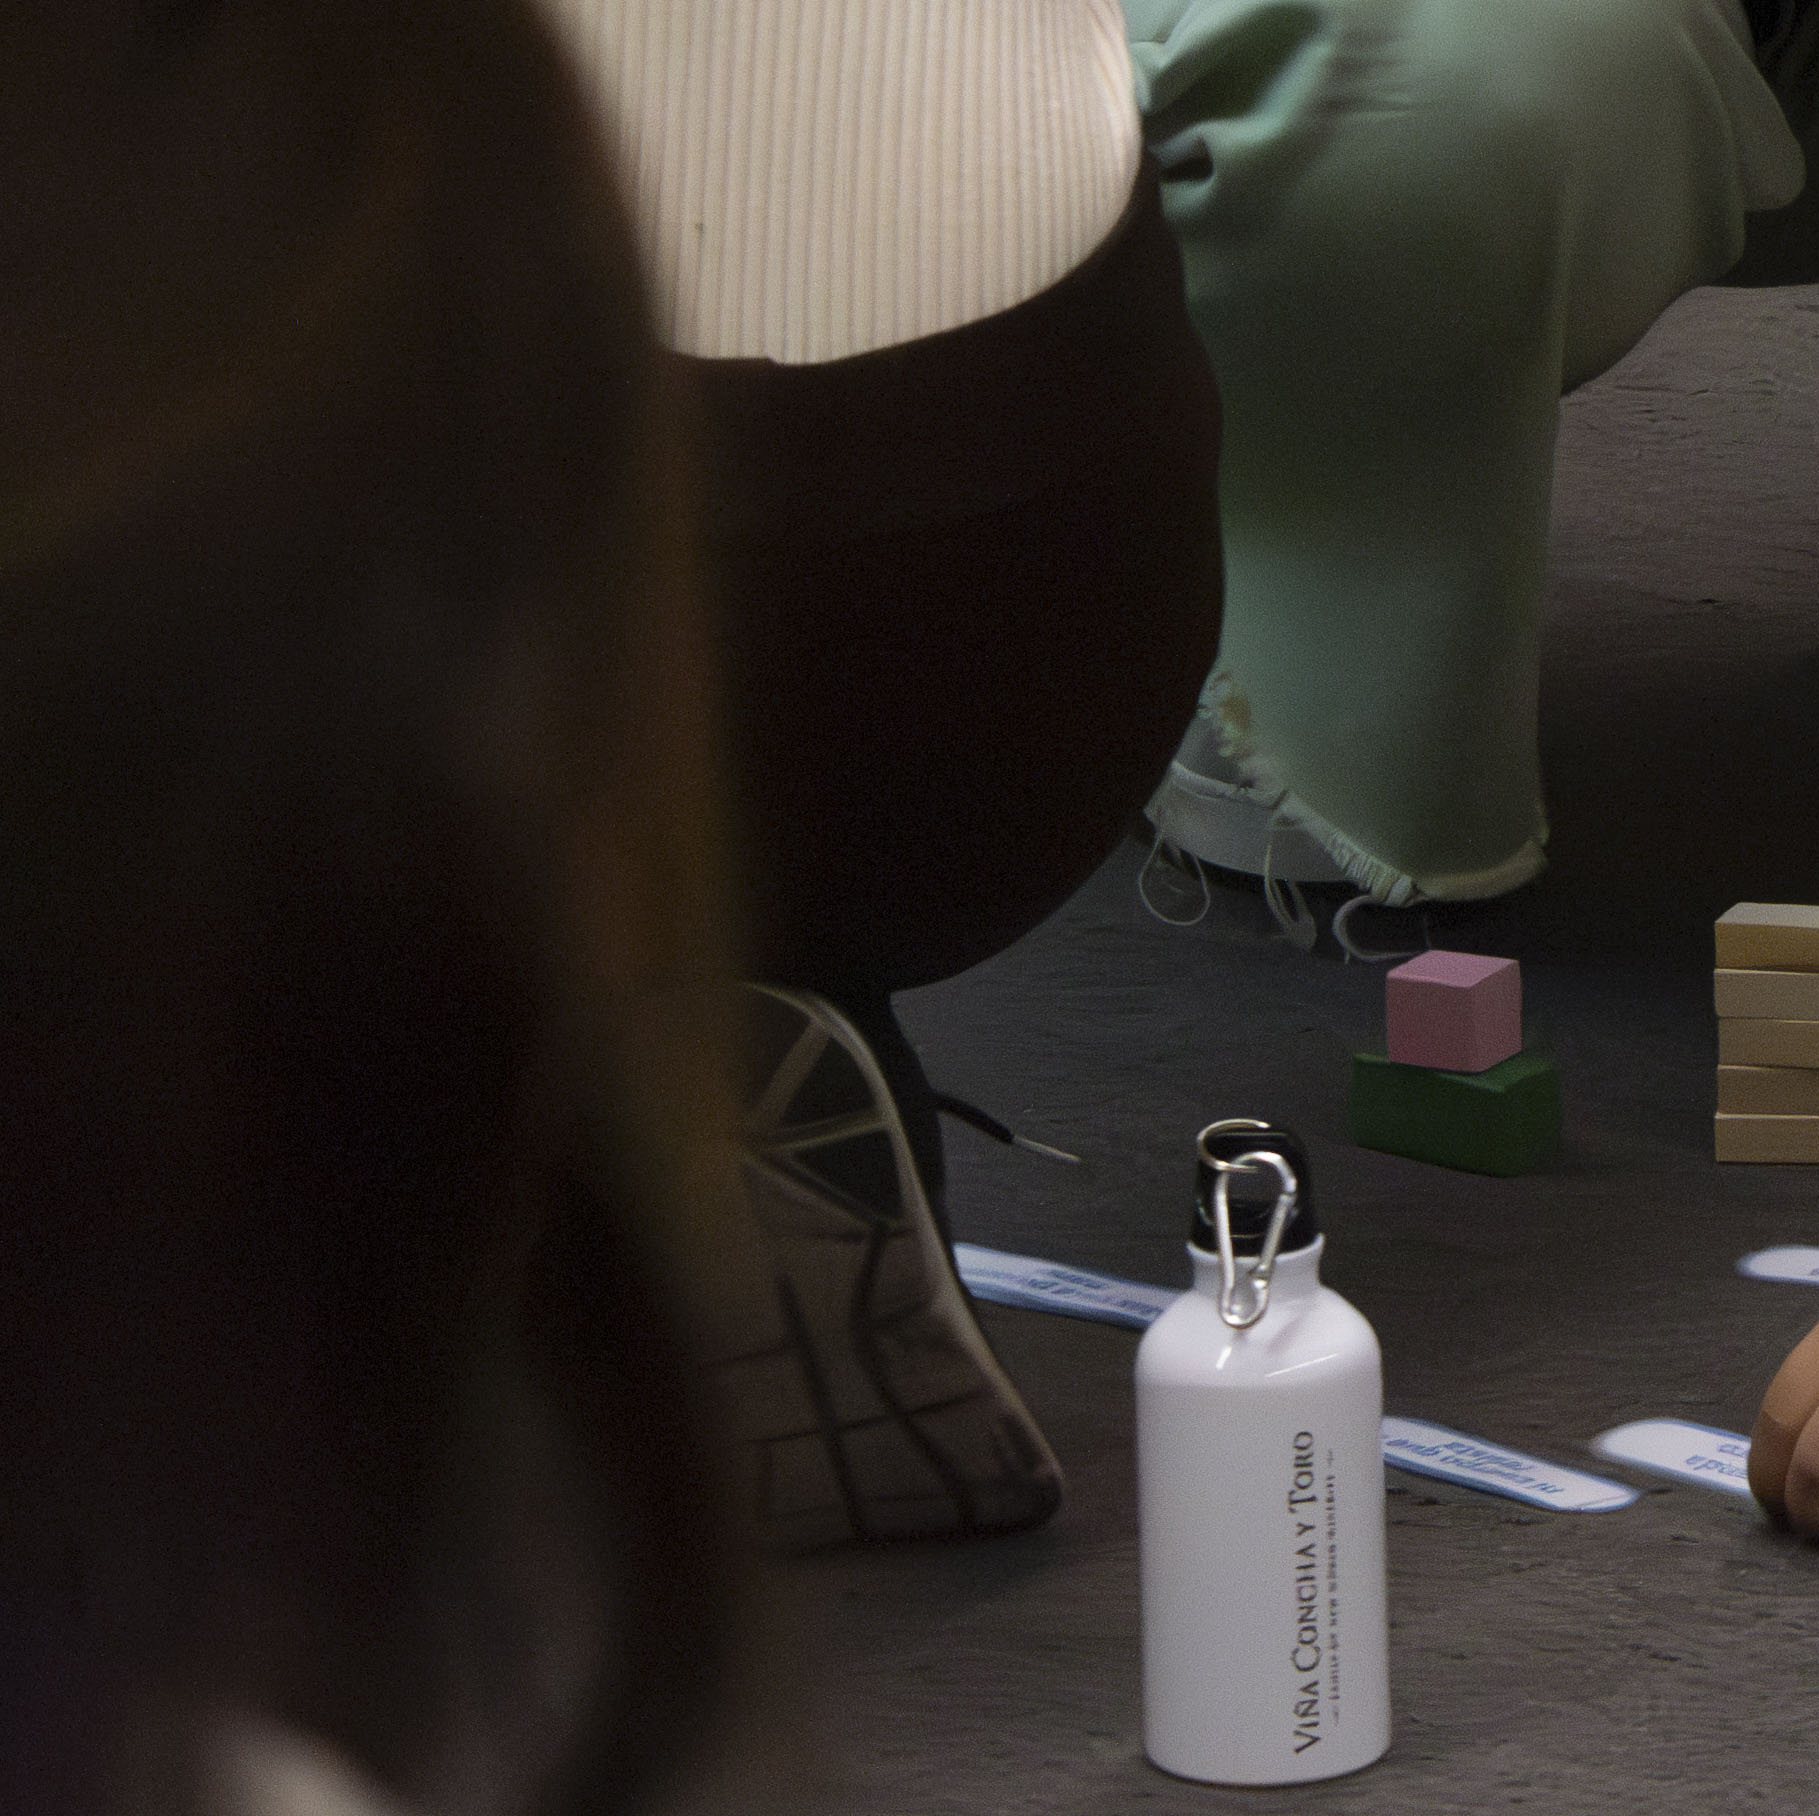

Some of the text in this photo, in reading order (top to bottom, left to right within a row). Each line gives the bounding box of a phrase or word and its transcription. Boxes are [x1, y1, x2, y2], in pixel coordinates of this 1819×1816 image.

[1288, 1431, 1321, 1753] VIÑA CONCHA Y TORO
